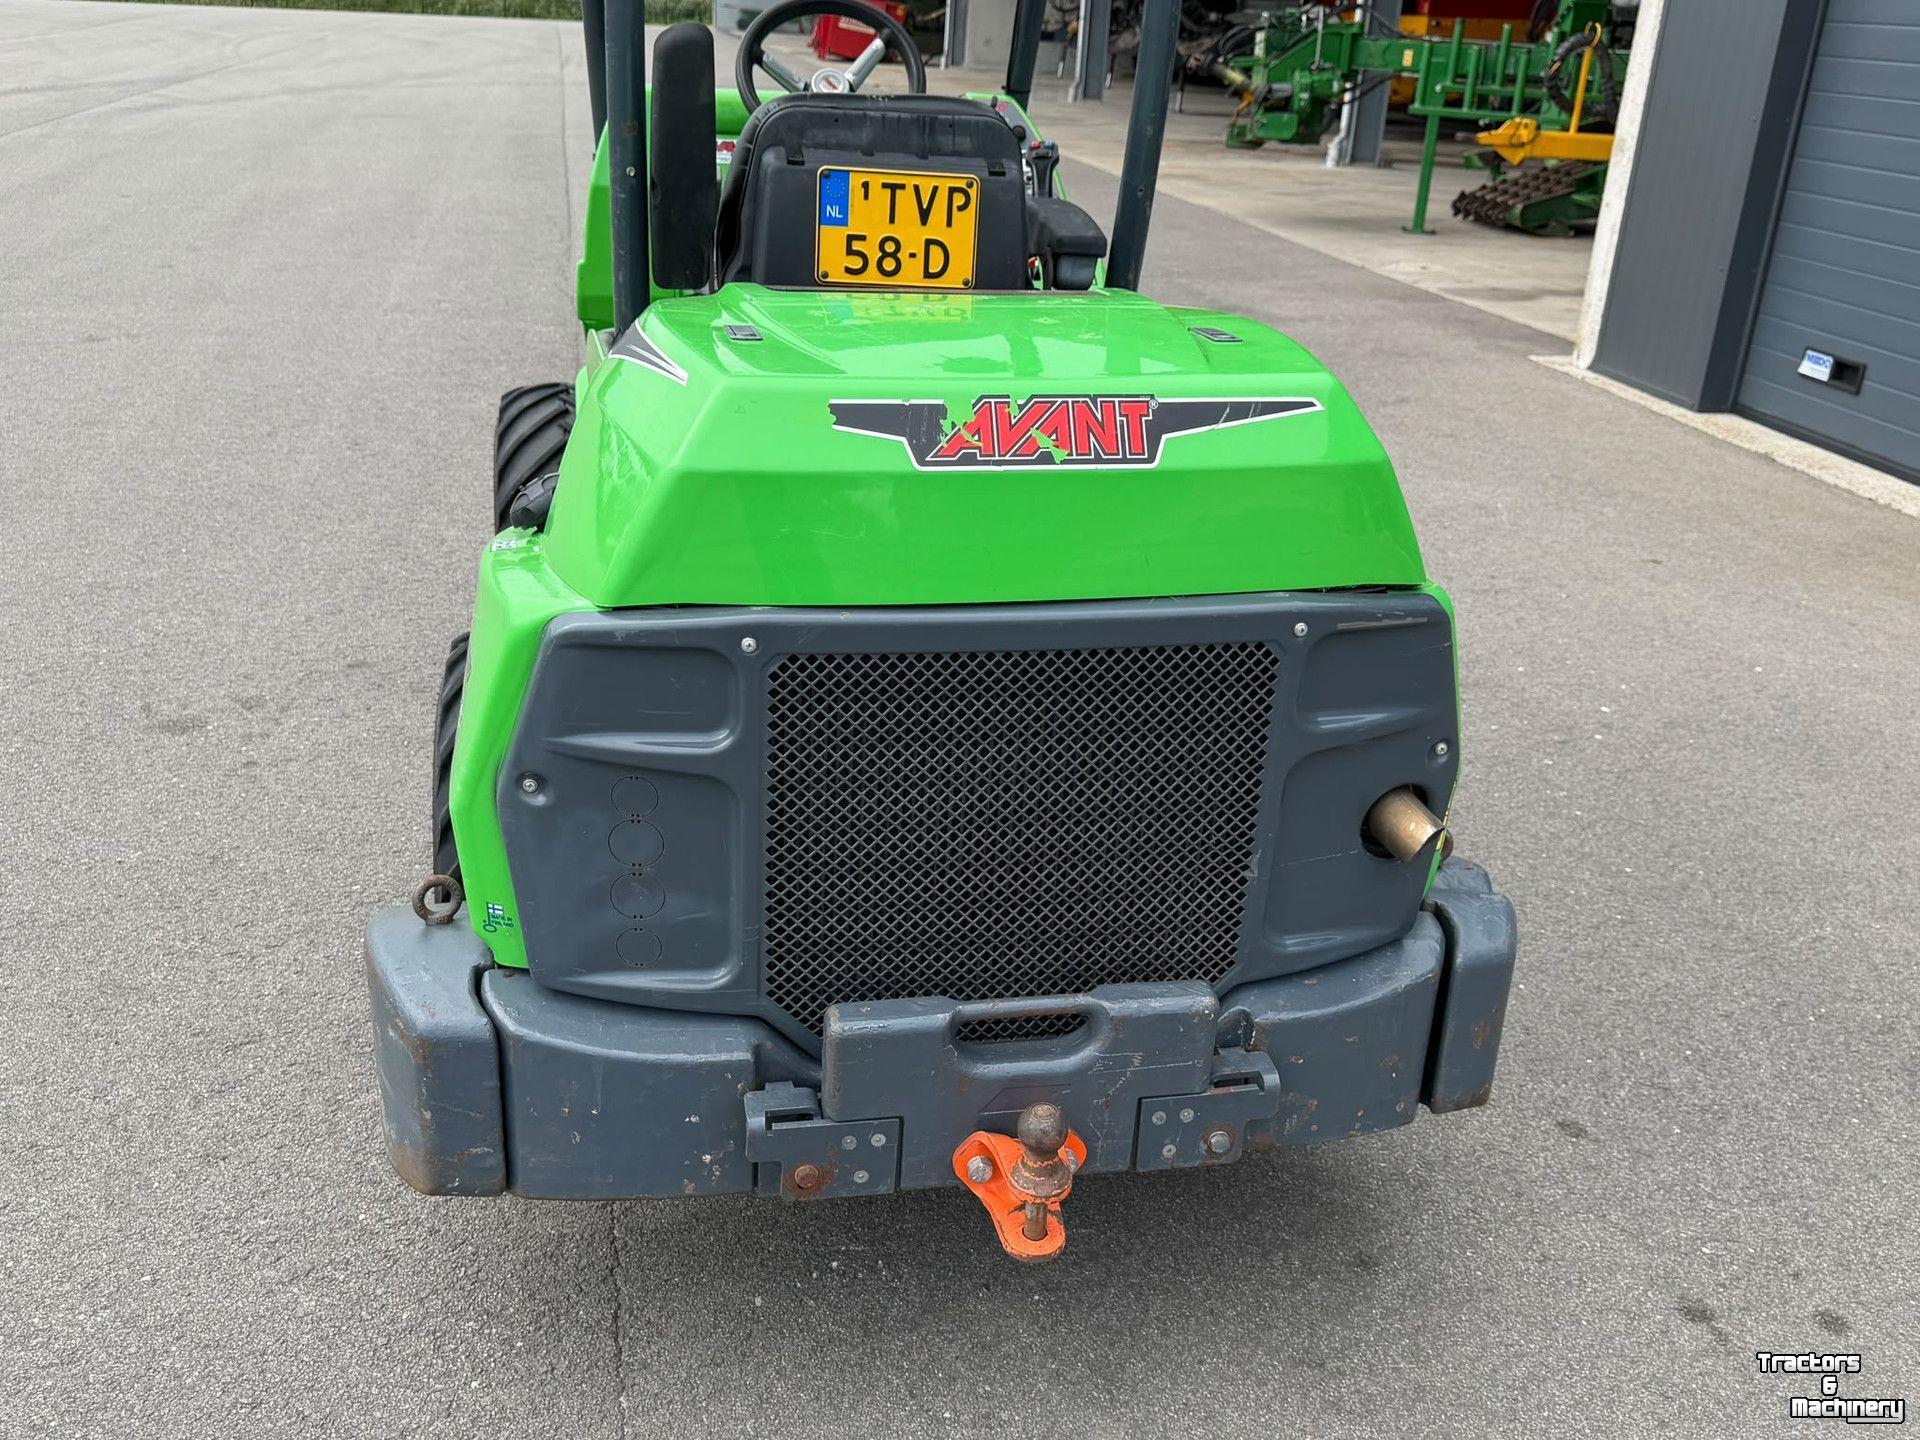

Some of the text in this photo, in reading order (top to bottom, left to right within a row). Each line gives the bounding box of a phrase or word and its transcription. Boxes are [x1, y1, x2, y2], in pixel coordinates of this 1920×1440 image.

[826, 205, 843, 218] NL
[881, 182, 971, 228] TVP
[844, 234, 950, 279] 58-D
[927, 398, 1153, 460] AVANT
